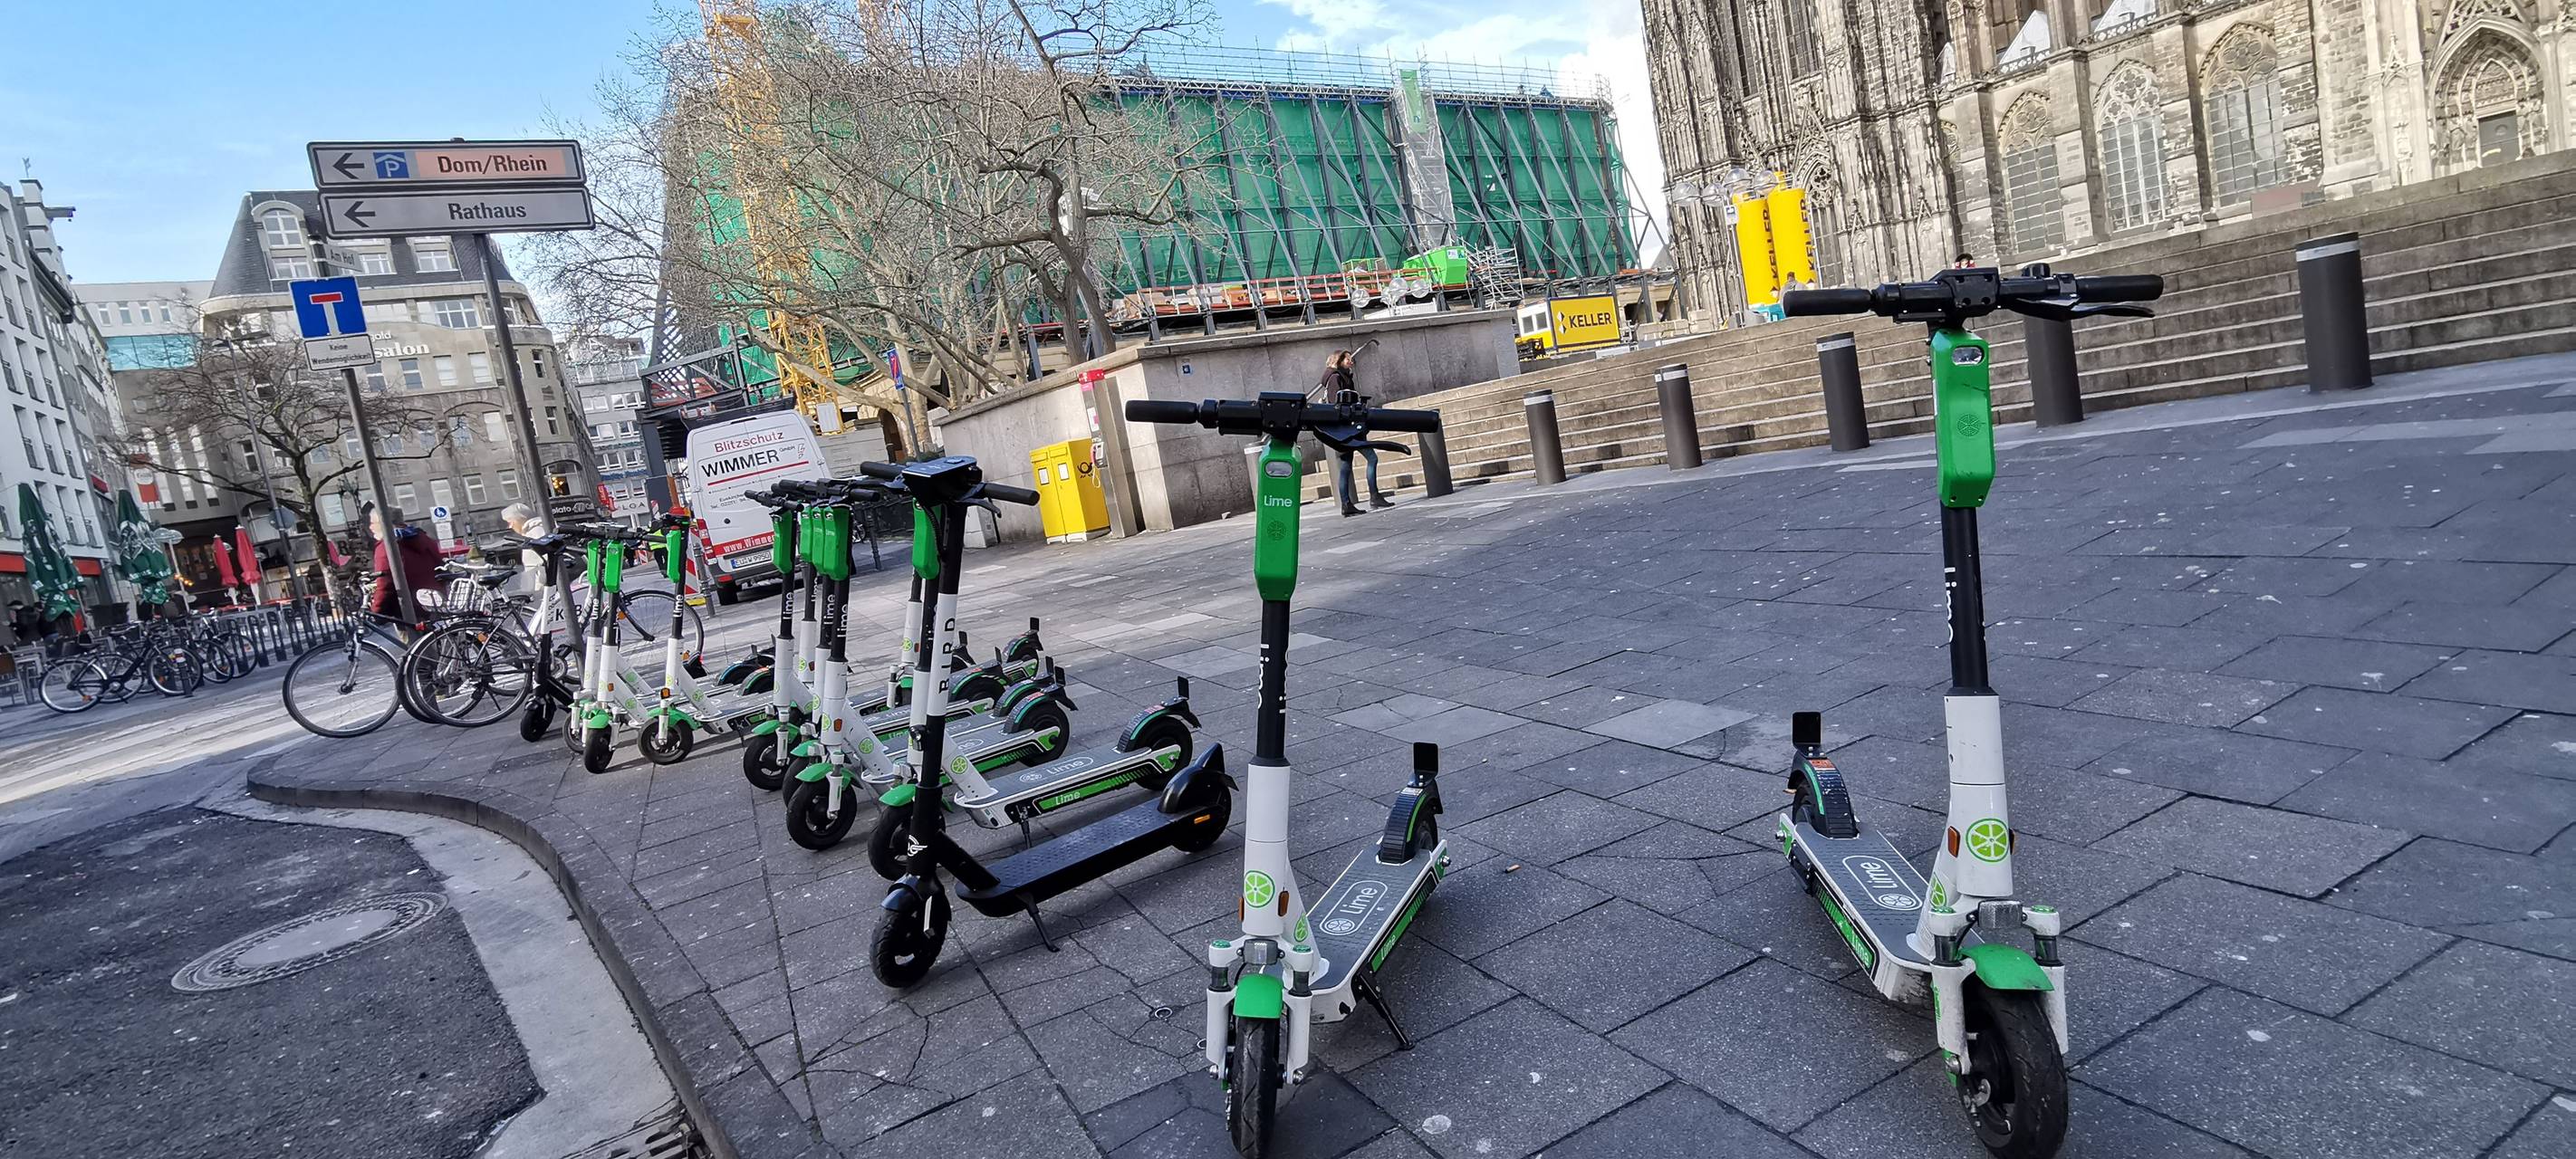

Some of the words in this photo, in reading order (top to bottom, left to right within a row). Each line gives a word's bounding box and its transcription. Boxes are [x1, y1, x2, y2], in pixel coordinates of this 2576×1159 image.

[437, 155, 548, 175] Dom/Rhein
[448, 202, 527, 220] Rathaus
[330, 249, 342, 263] Am
[343, 252, 355, 265] Hof
[1569, 312, 1613, 329] KELLER
[714, 431, 784, 453] Blitzschutz
[701, 449, 780, 477] WIMMER
[1264, 495, 1293, 508] Lime
[822, 594, 836, 625] Lime
[938, 618, 956, 694] BIRD
[1046, 760, 1085, 775] Lime
[1055, 790, 1081, 806] Lime
[1860, 862, 1898, 889] Lime
[1340, 887, 1379, 915] Lime
[1380, 934, 1396, 962] Lime
